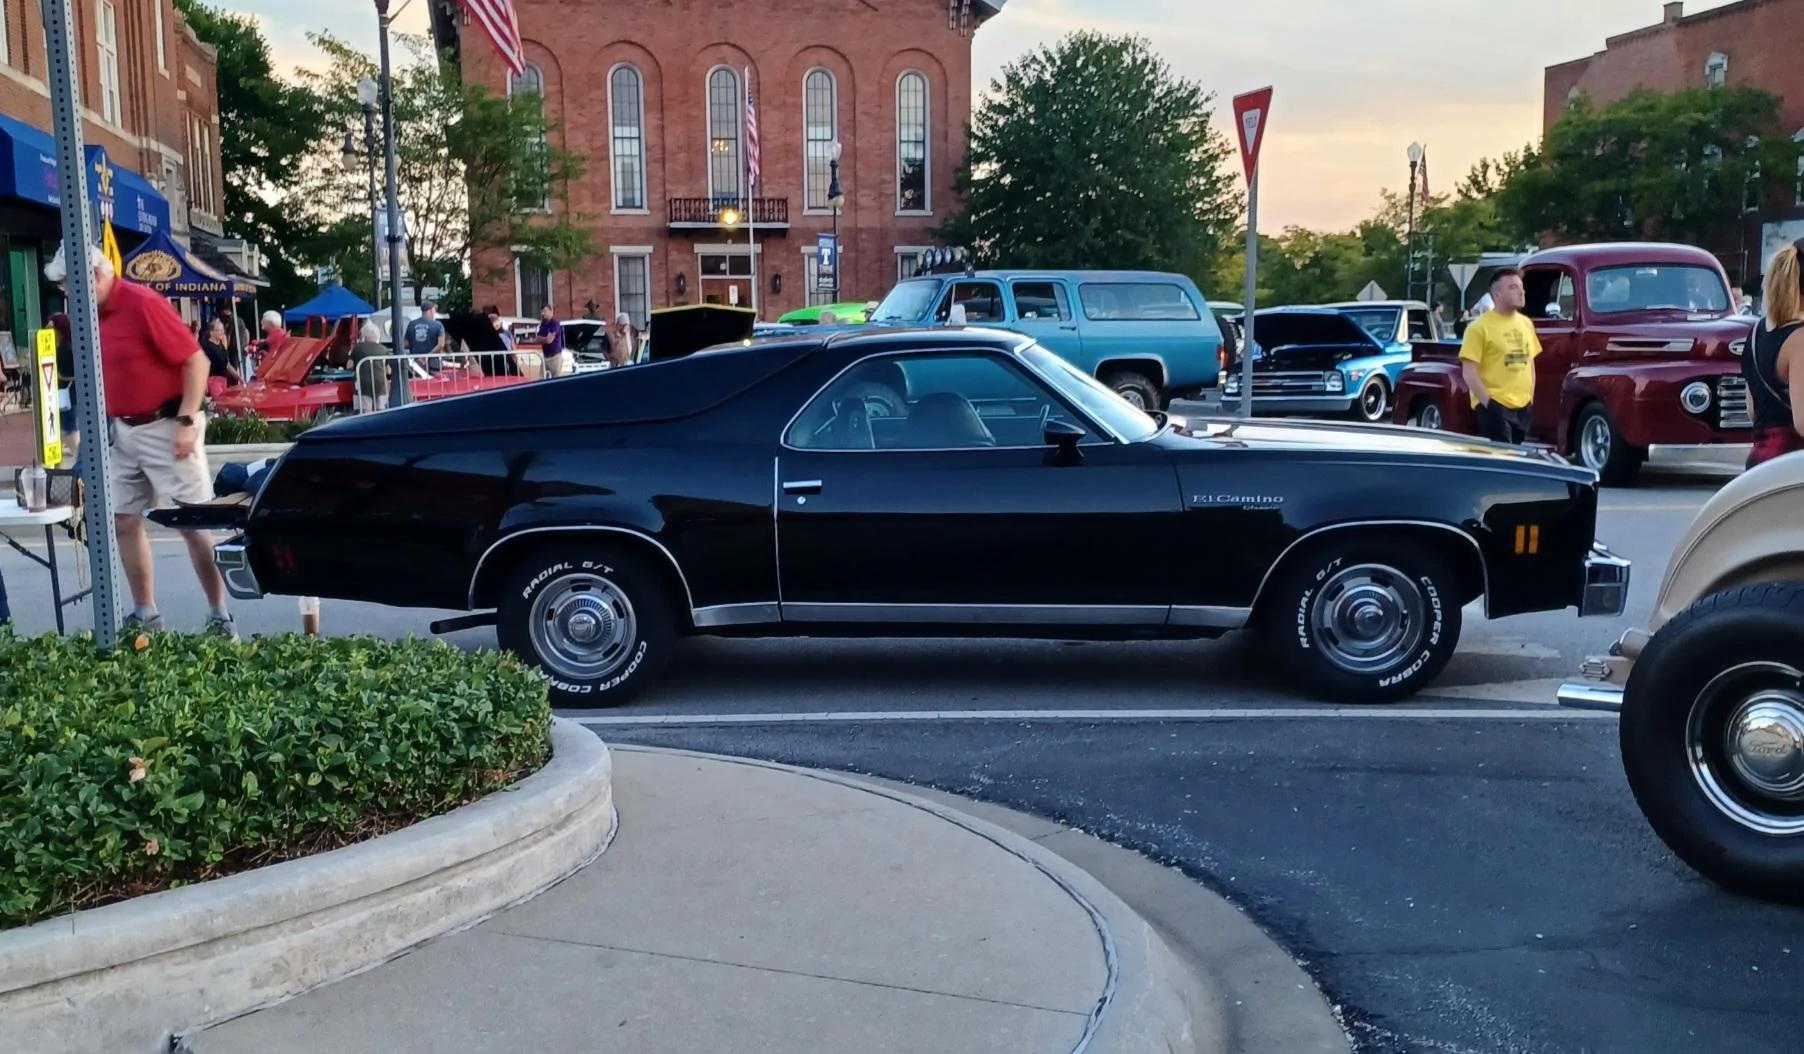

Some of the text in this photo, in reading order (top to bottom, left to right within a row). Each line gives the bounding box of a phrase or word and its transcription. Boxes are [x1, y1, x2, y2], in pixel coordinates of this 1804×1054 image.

[821, 248, 831, 265] T
[156, 282, 171, 292] OF
[176, 282, 227, 292] INDIANA
[1216, 494, 1284, 503] Camino
[522, 561, 574, 599] RADIAL
[1297, 588, 1313, 649] RADIAL
[1378, 576, 1443, 688] COOPER COBRA
[599, 640, 648, 692] COOPER
